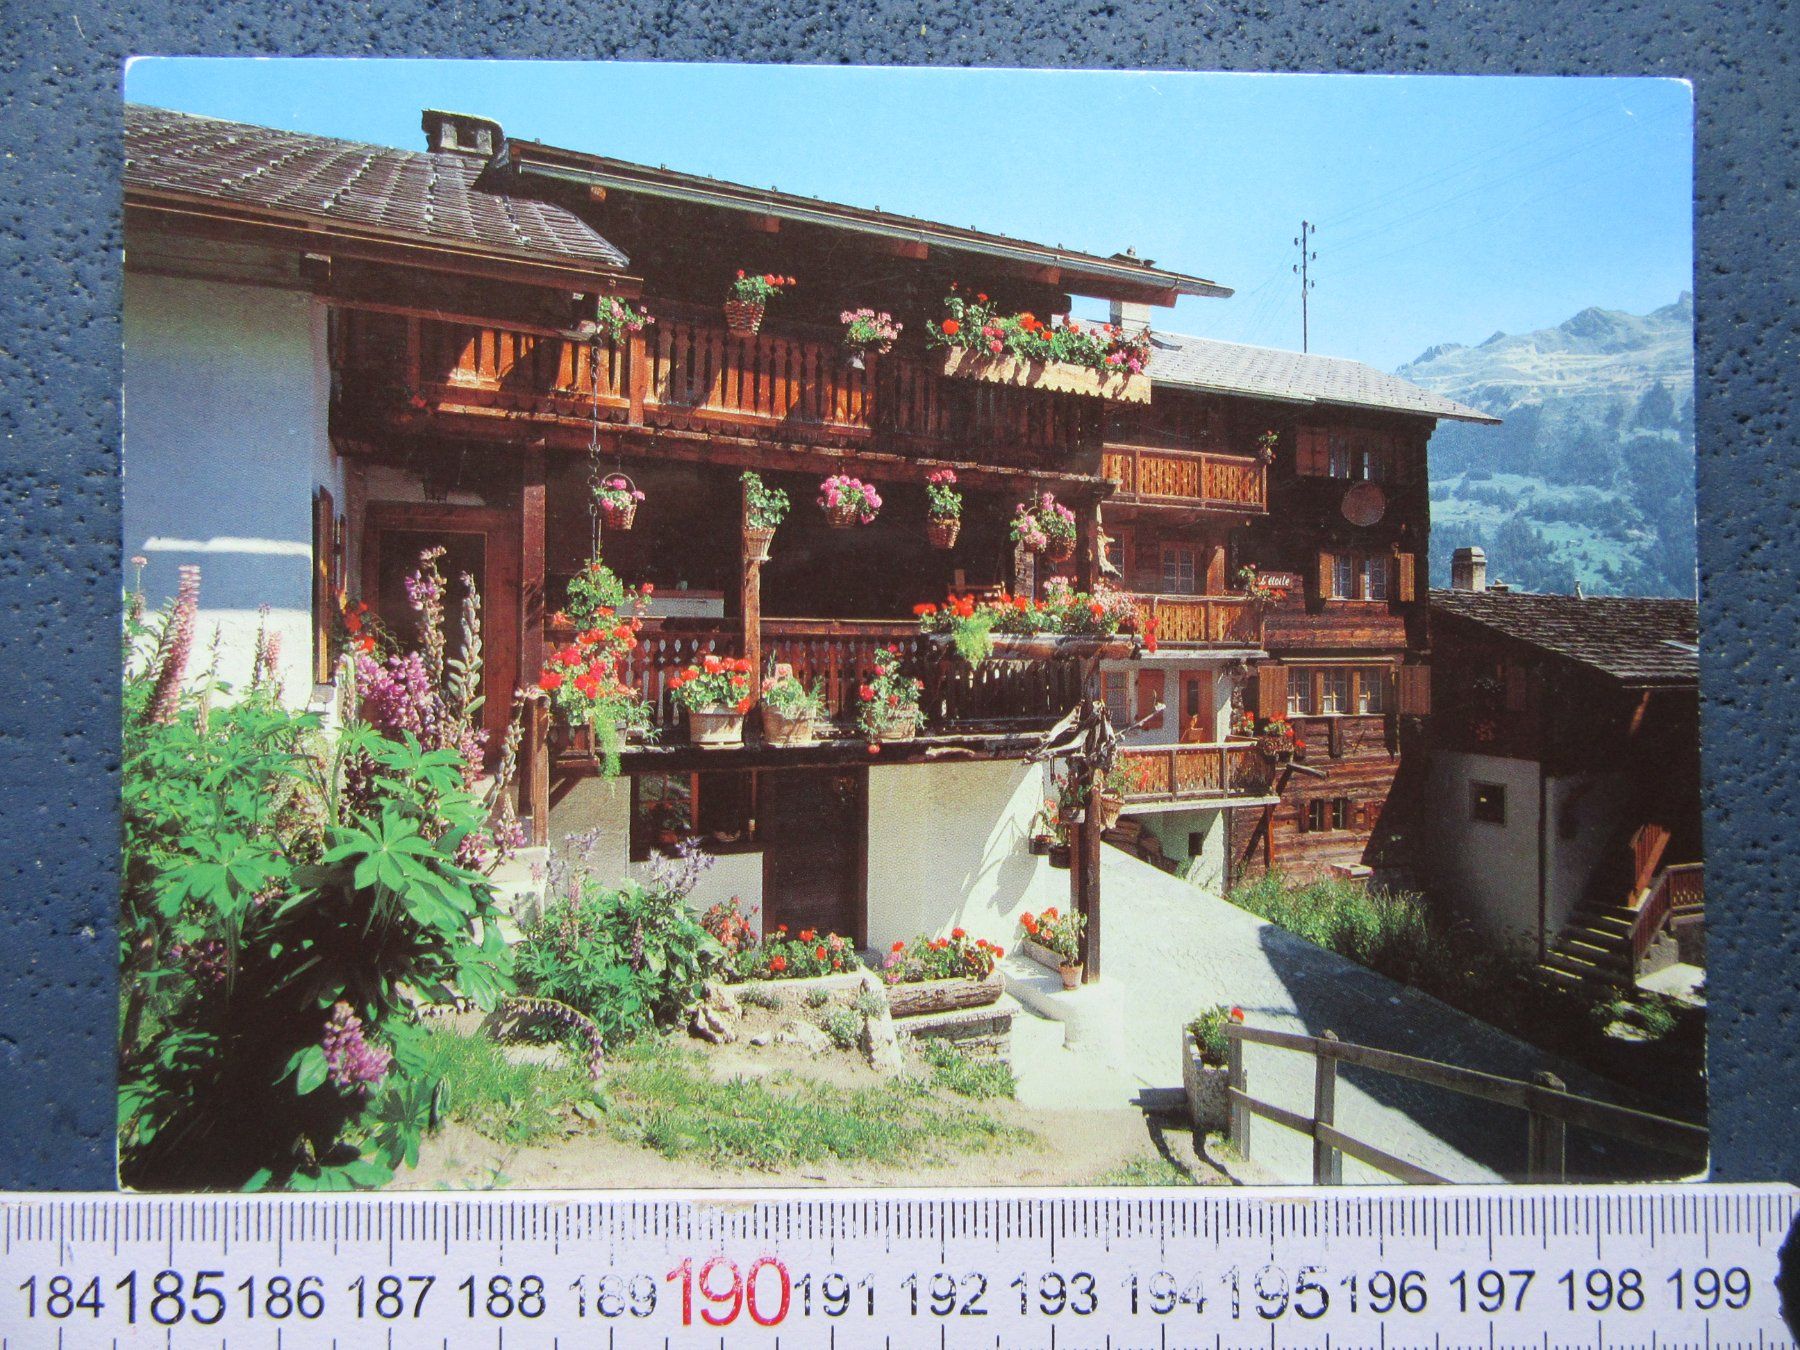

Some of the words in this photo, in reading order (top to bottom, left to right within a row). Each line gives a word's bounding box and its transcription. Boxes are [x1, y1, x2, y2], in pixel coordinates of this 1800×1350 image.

[19, 1275, 105, 1319] 184
[116, 1270, 226, 1325] 185
[238, 1276, 325, 1319] 186
[347, 1276, 436, 1318] 187
[458, 1275, 547, 1319] 188
[567, 1275, 658, 1319] 189
[665, 1257, 791, 1327] 190
[793, 1274, 877, 1317] 191
[900, 1273, 988, 1317] 192
[1009, 1271, 1099, 1316] 193
[1120, 1271, 1208, 1316] 194
[1220, 1264, 1331, 1320] 195
[1341, 1270, 1429, 1314] 196
[1449, 1270, 1536, 1313] 197
[1558, 1268, 1646, 1312] 198
[1667, 1267, 1752, 1311] 199
